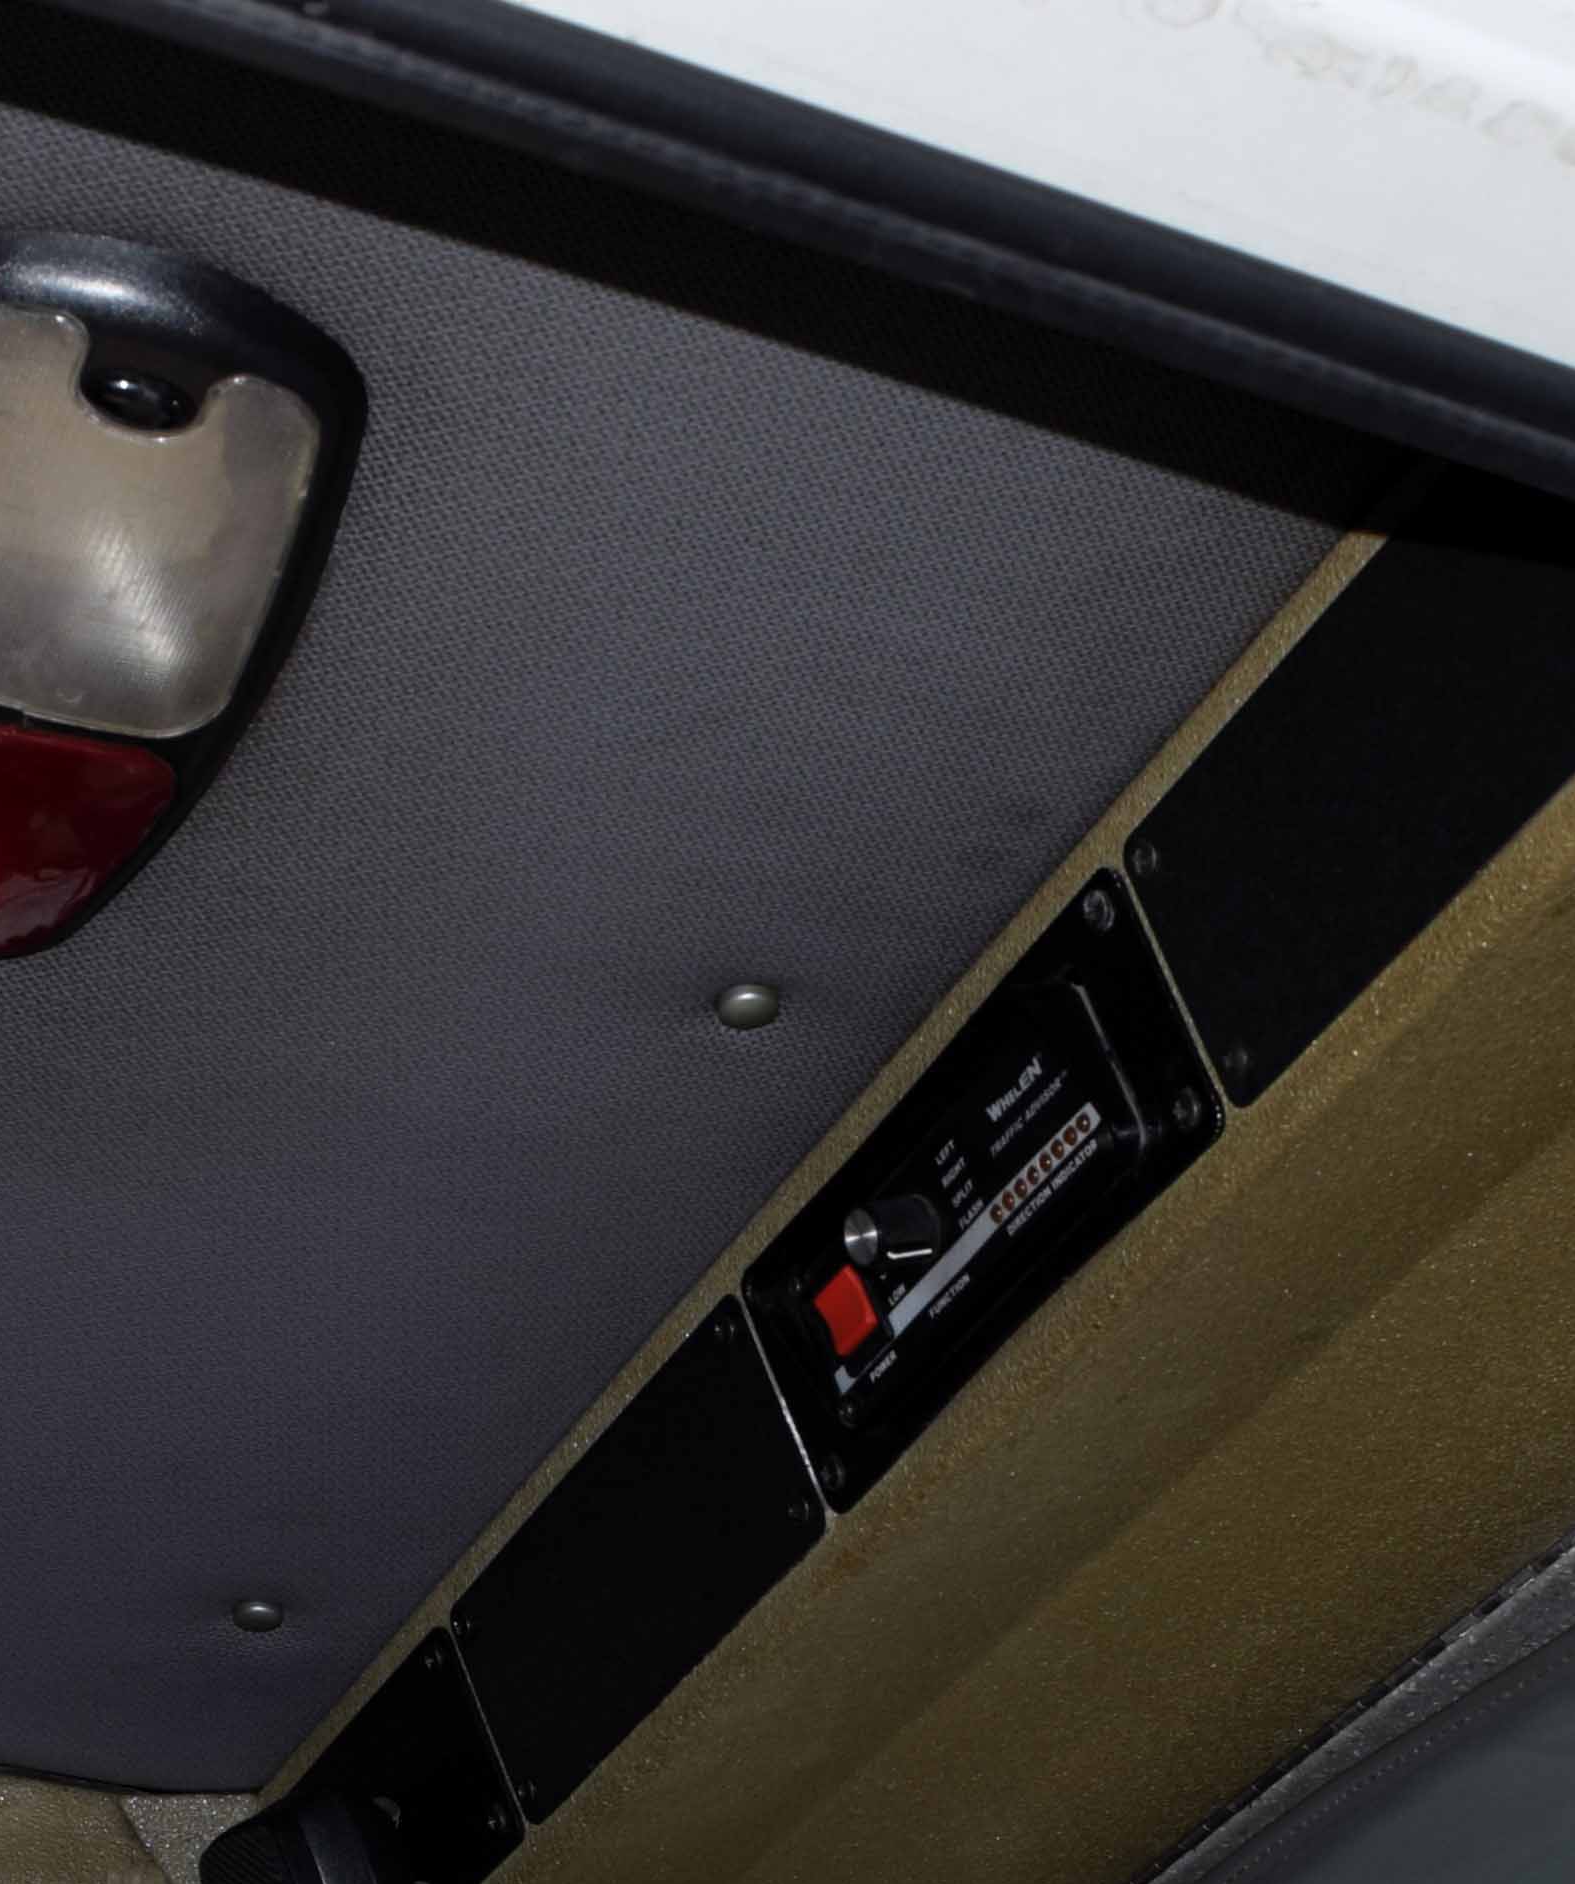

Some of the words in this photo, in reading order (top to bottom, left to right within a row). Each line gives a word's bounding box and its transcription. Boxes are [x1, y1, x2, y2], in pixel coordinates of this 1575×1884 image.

[934, 1138, 955, 1165] LEFT
[941, 1156, 965, 1188] RIGHT
[1006, 1185, 1053, 1236] DIRECTION
[1050, 1138, 1098, 1189] INDICATOR
[952, 1178, 974, 1208] SPLIT
[958, 1198, 985, 1230] FLASH
[929, 1272, 970, 1319] FUNCTION
[869, 1349, 897, 1384] POWER
